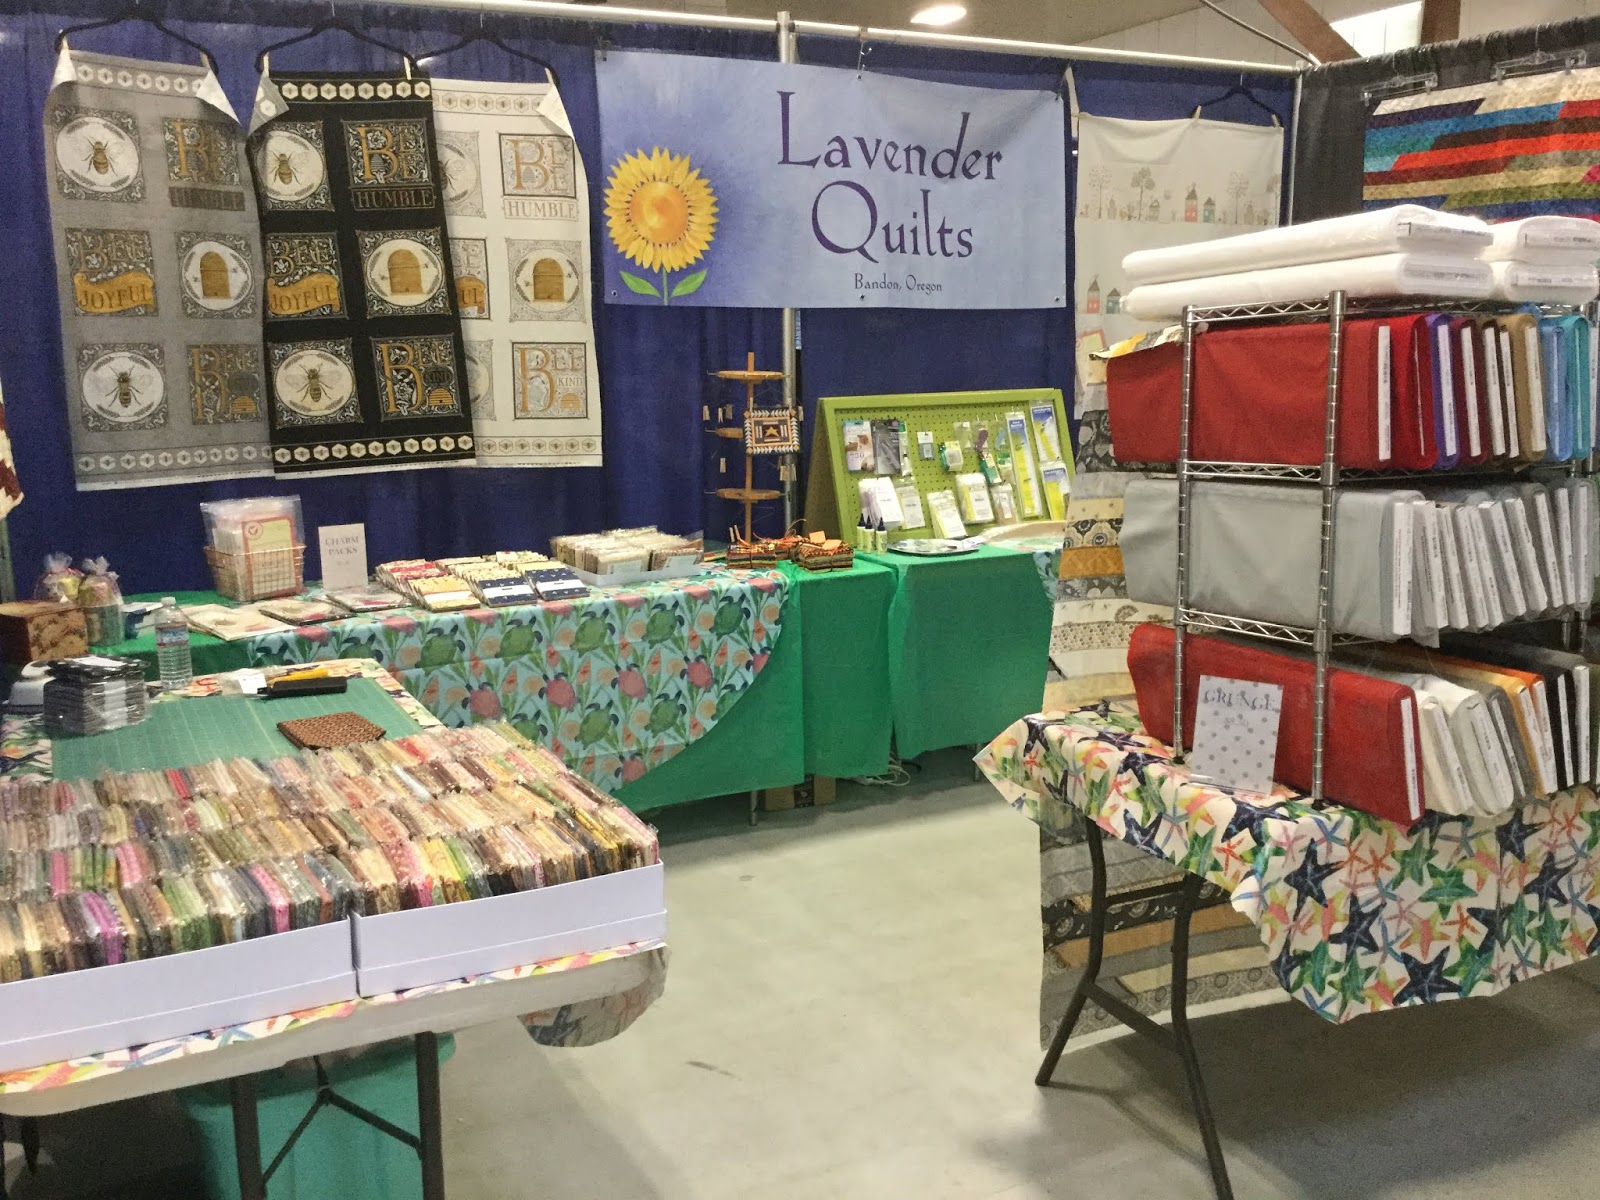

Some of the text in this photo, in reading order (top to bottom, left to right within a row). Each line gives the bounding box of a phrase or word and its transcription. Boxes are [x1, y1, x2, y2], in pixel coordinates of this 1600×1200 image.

[777, 91, 1003, 180] Lavender
[357, 190, 432, 208] HUMBLE
[507, 201, 576, 219] HUMBLE
[811, 180, 973, 264] Quilts
[854, 273, 943, 296] Bandon, Oregon
[79, 284, 152, 309] JOYFUL
[270, 285, 338, 311] JOYFUL
[558, 377, 583, 387] KIND
[325, 536, 359, 545] CHARM
[328, 547, 357, 555] PACKS
[1204, 689, 1276, 711] GRUNGE
